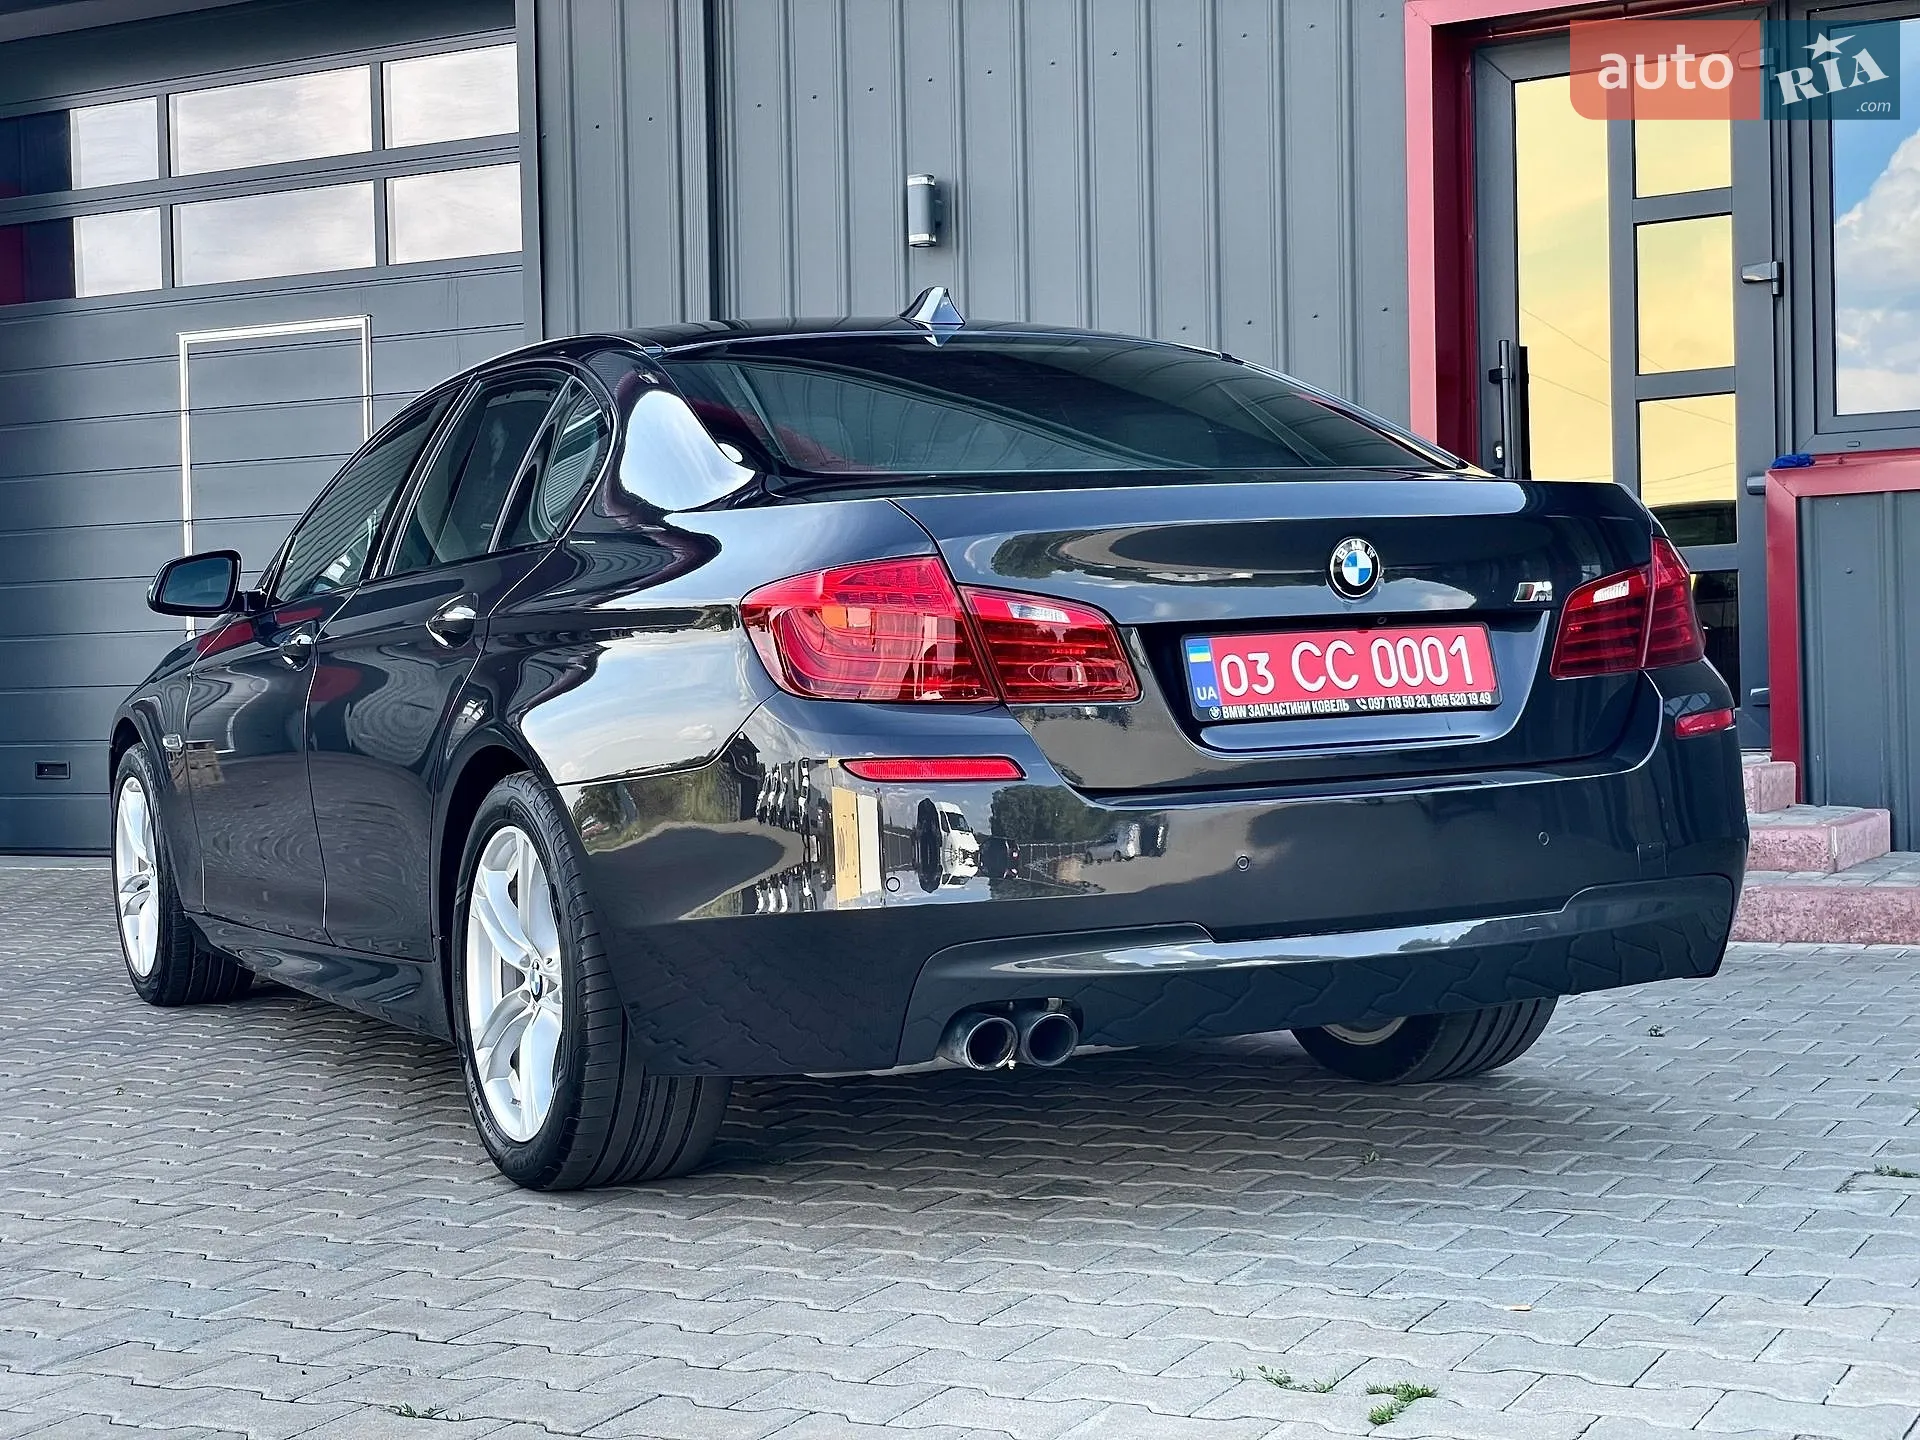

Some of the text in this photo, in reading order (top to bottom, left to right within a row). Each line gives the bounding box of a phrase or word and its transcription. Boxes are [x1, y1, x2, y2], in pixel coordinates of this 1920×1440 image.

[1220, 635, 1474, 697] 03 CC 0001
[1197, 686, 1218, 701] UA
[1222, 706, 1247, 719] BMW
[1248, 701, 1312, 717] ЗАПЧАСТИНИ
[1313, 699, 1350, 713] КОВЕЛЬ
[1368, 697, 1385, 710] 097
[1387, 696, 1402, 709] 118
[1402, 695, 1415, 708] 50
[1431, 694, 1449, 707] 096
[1450, 693, 1467, 706] 520
[1468, 692, 1479, 705] 19
[1480, 691, 1492, 704] 49
